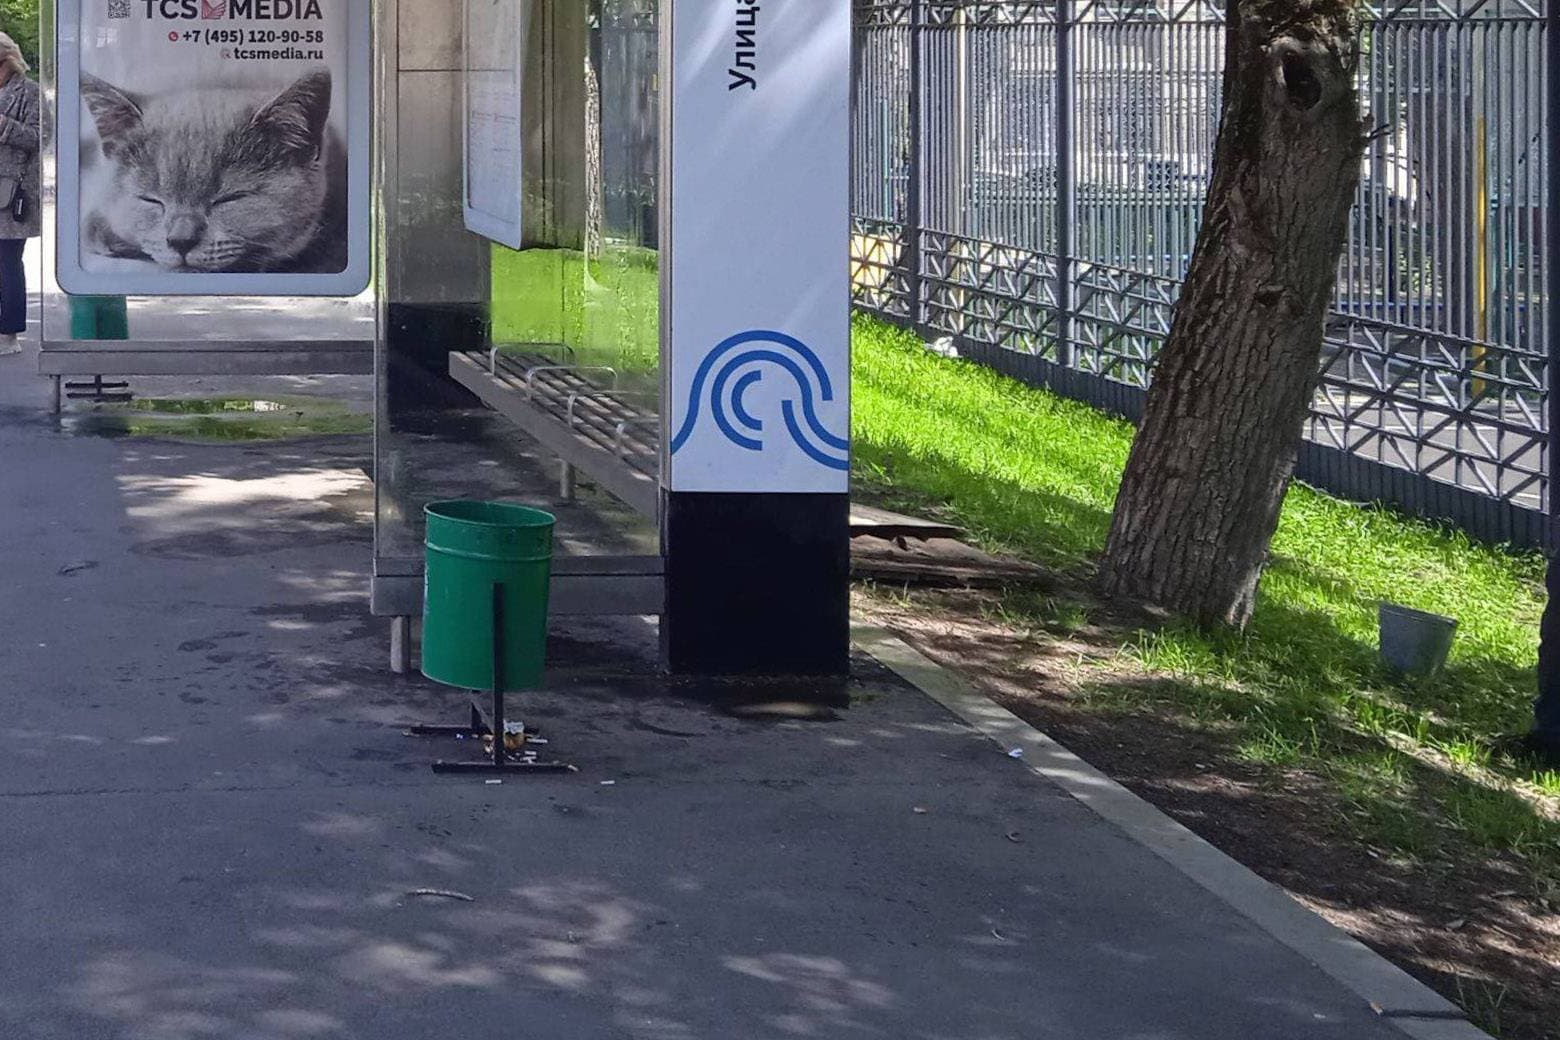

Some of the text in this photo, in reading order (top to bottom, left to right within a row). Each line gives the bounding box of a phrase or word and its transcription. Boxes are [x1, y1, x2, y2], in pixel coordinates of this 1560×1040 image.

[182, 29, 324, 45] +7 (495) 120-90-58
[234, 48, 324, 60] tcsmedia.ru
